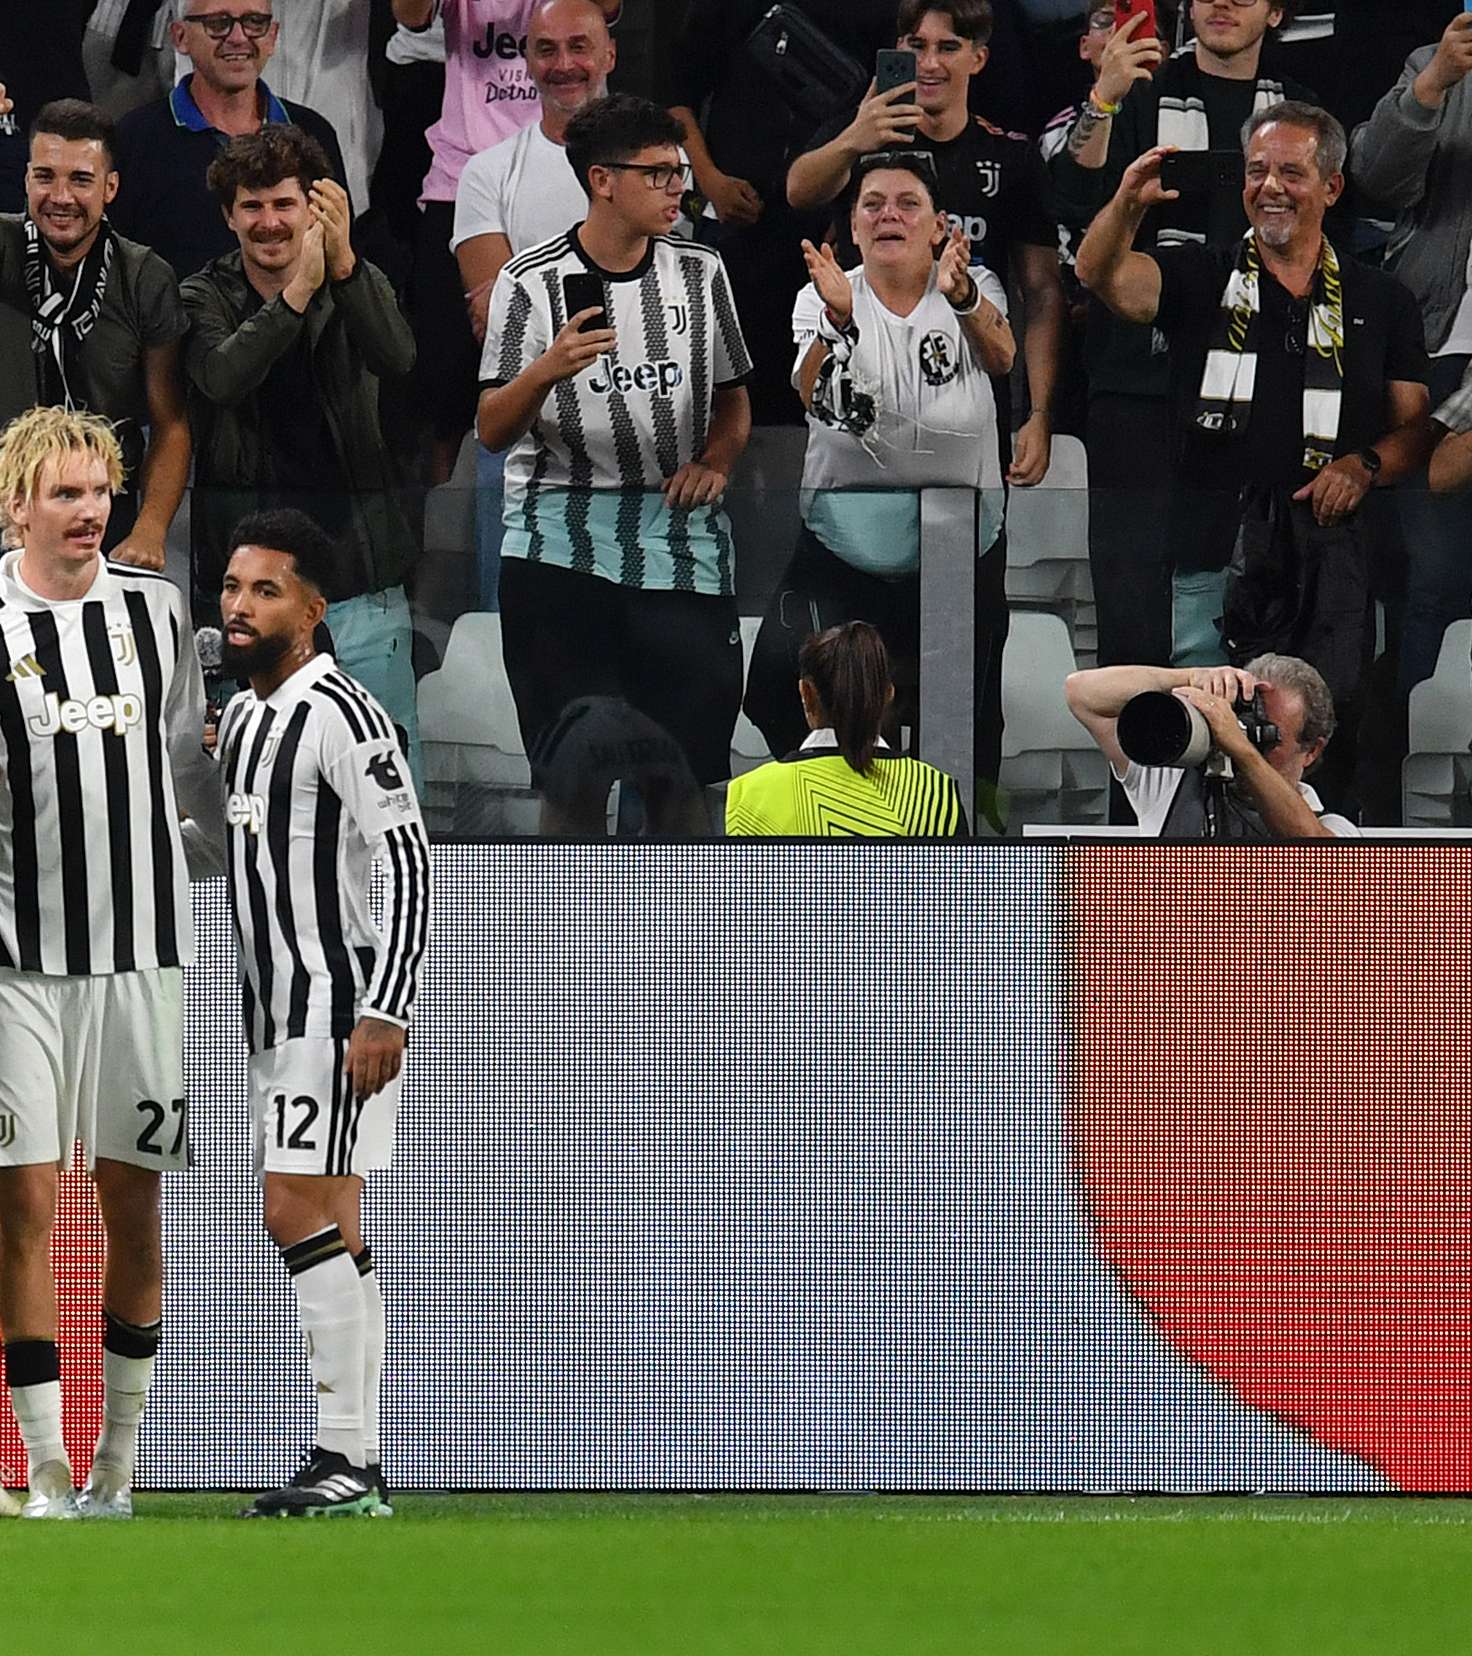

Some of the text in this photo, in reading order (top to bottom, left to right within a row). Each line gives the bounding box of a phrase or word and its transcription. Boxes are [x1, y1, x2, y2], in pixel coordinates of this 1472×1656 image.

[473, 21, 528, 60] Je
[587, 354, 684, 398] Jeep
[28, 691, 142, 737] Jeep
[136, 1098, 187, 1156] 27
[273, 1094, 320, 1151] 12
